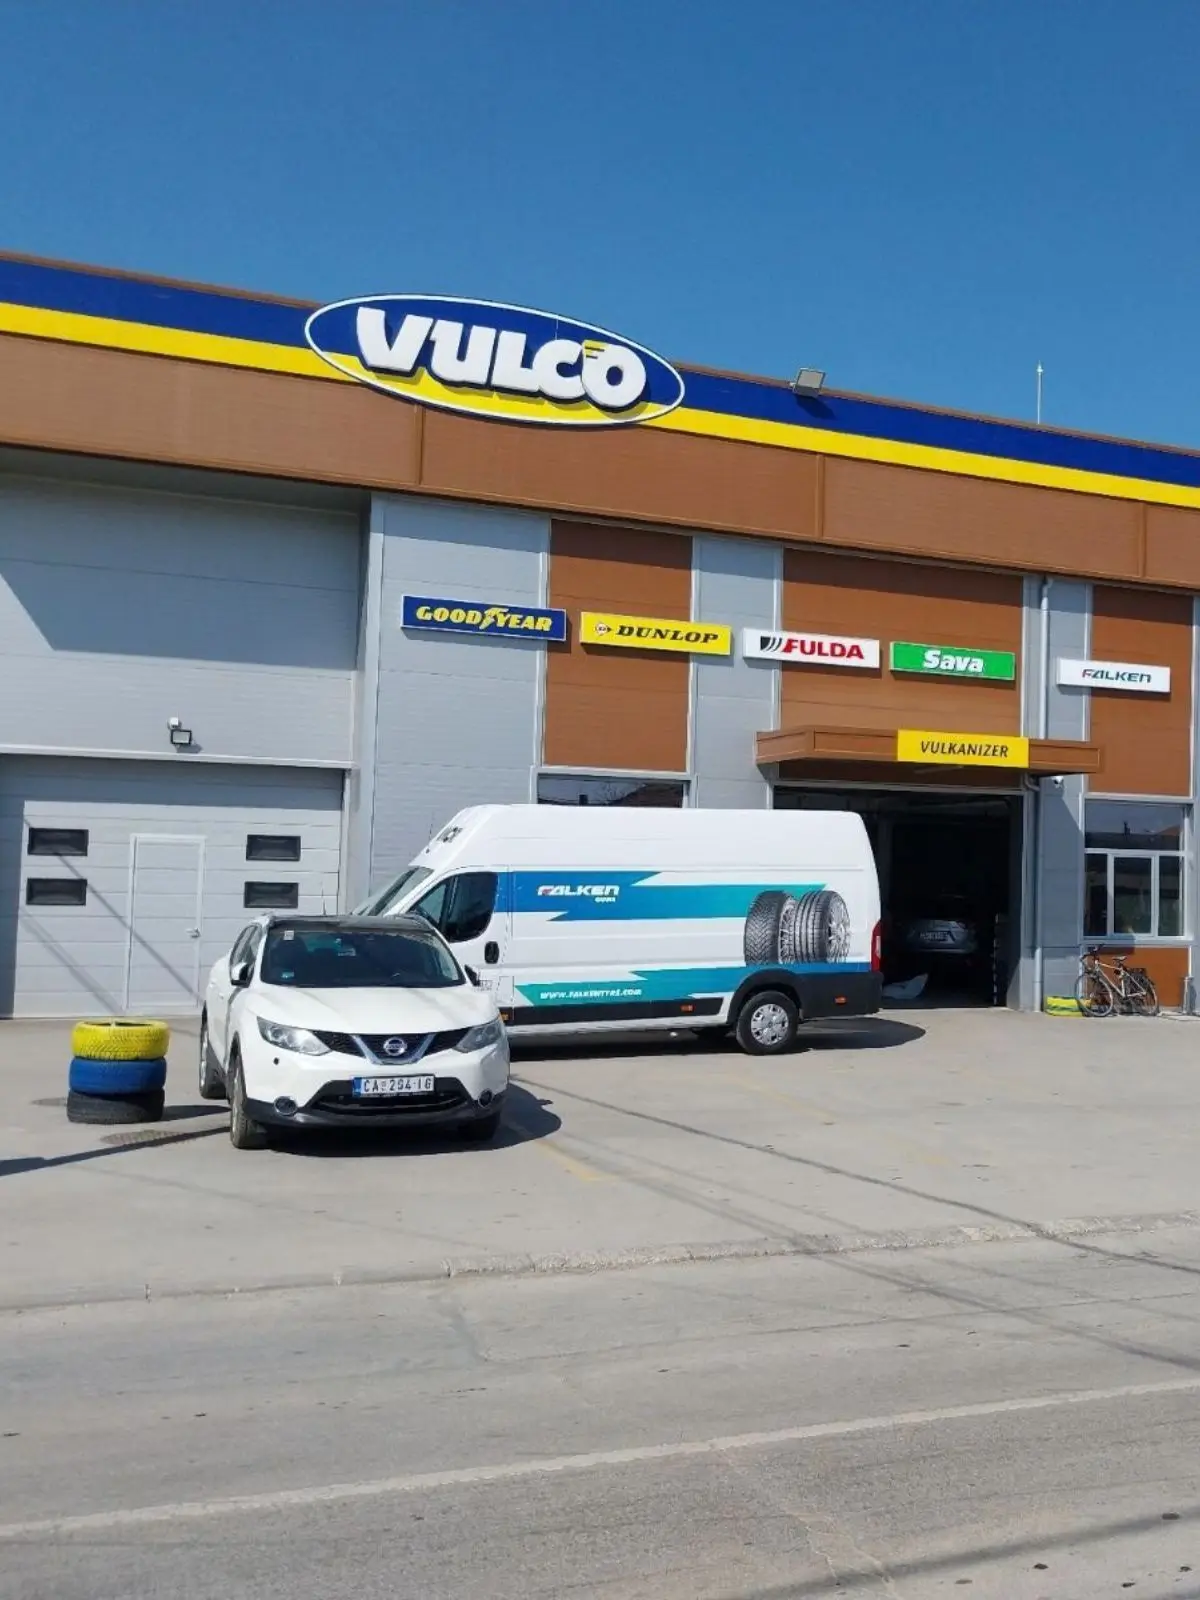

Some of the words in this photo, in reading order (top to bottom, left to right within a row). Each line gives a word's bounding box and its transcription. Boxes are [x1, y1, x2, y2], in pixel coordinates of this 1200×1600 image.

[356, 306, 646, 407] VULCO
[415, 605, 553, 632] GOODYEAR
[616, 624, 719, 644] DUNLOP
[783, 638, 864, 660] FULDA
[923, 649, 984, 673] Sava
[1081, 668, 1152, 683] FALKEN
[920, 740, 1009, 758] VULKANIZER
[537, 884, 620, 896] FALKEN
